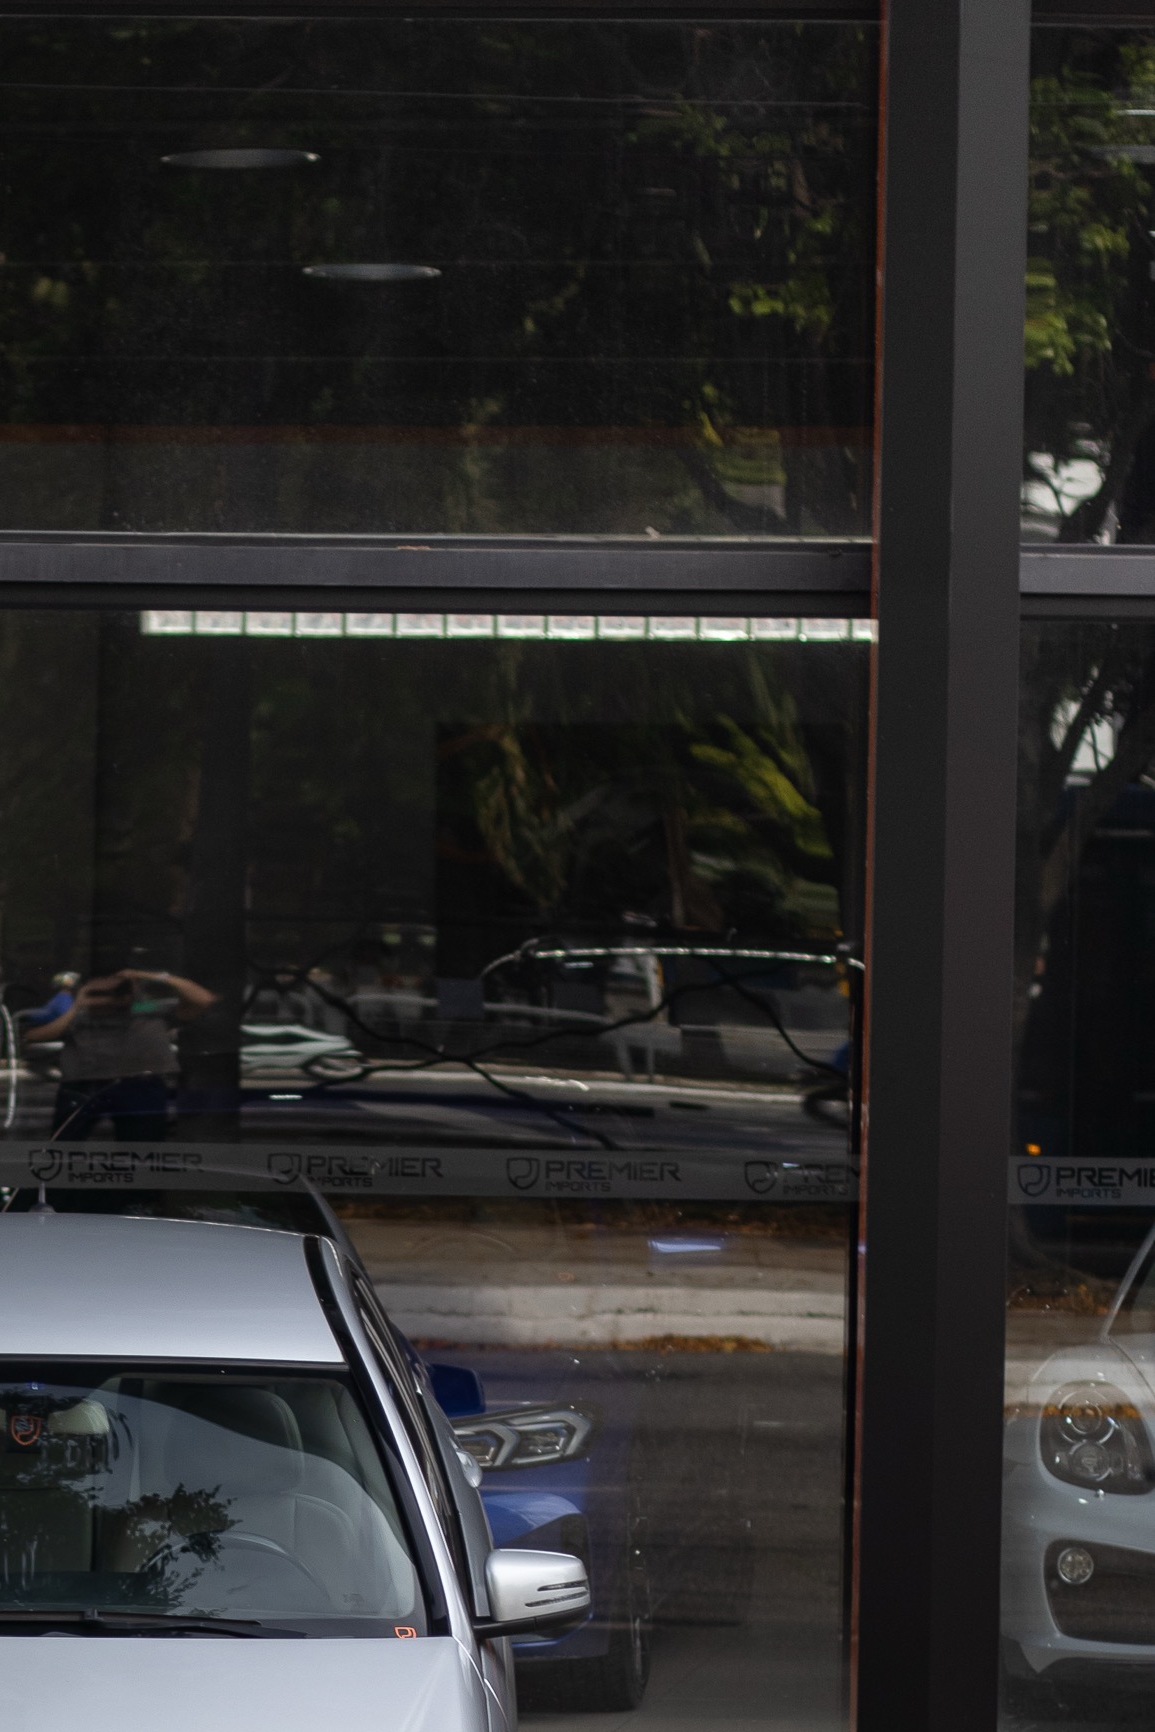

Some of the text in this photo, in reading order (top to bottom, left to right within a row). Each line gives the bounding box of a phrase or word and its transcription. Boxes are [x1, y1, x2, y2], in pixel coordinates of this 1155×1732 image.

[67, 1151, 206, 1173] PREMIER
[306, 1155, 445, 1178] PREMIER
[544, 1159, 683, 1182] PREMIER
[67, 1172, 135, 1184] IMPORTS
[544, 1180, 612, 1193] IMPORTS
[1056, 1166, 1155, 1187] PREMI
[1056, 1187, 1122, 1199] IMPORTS
